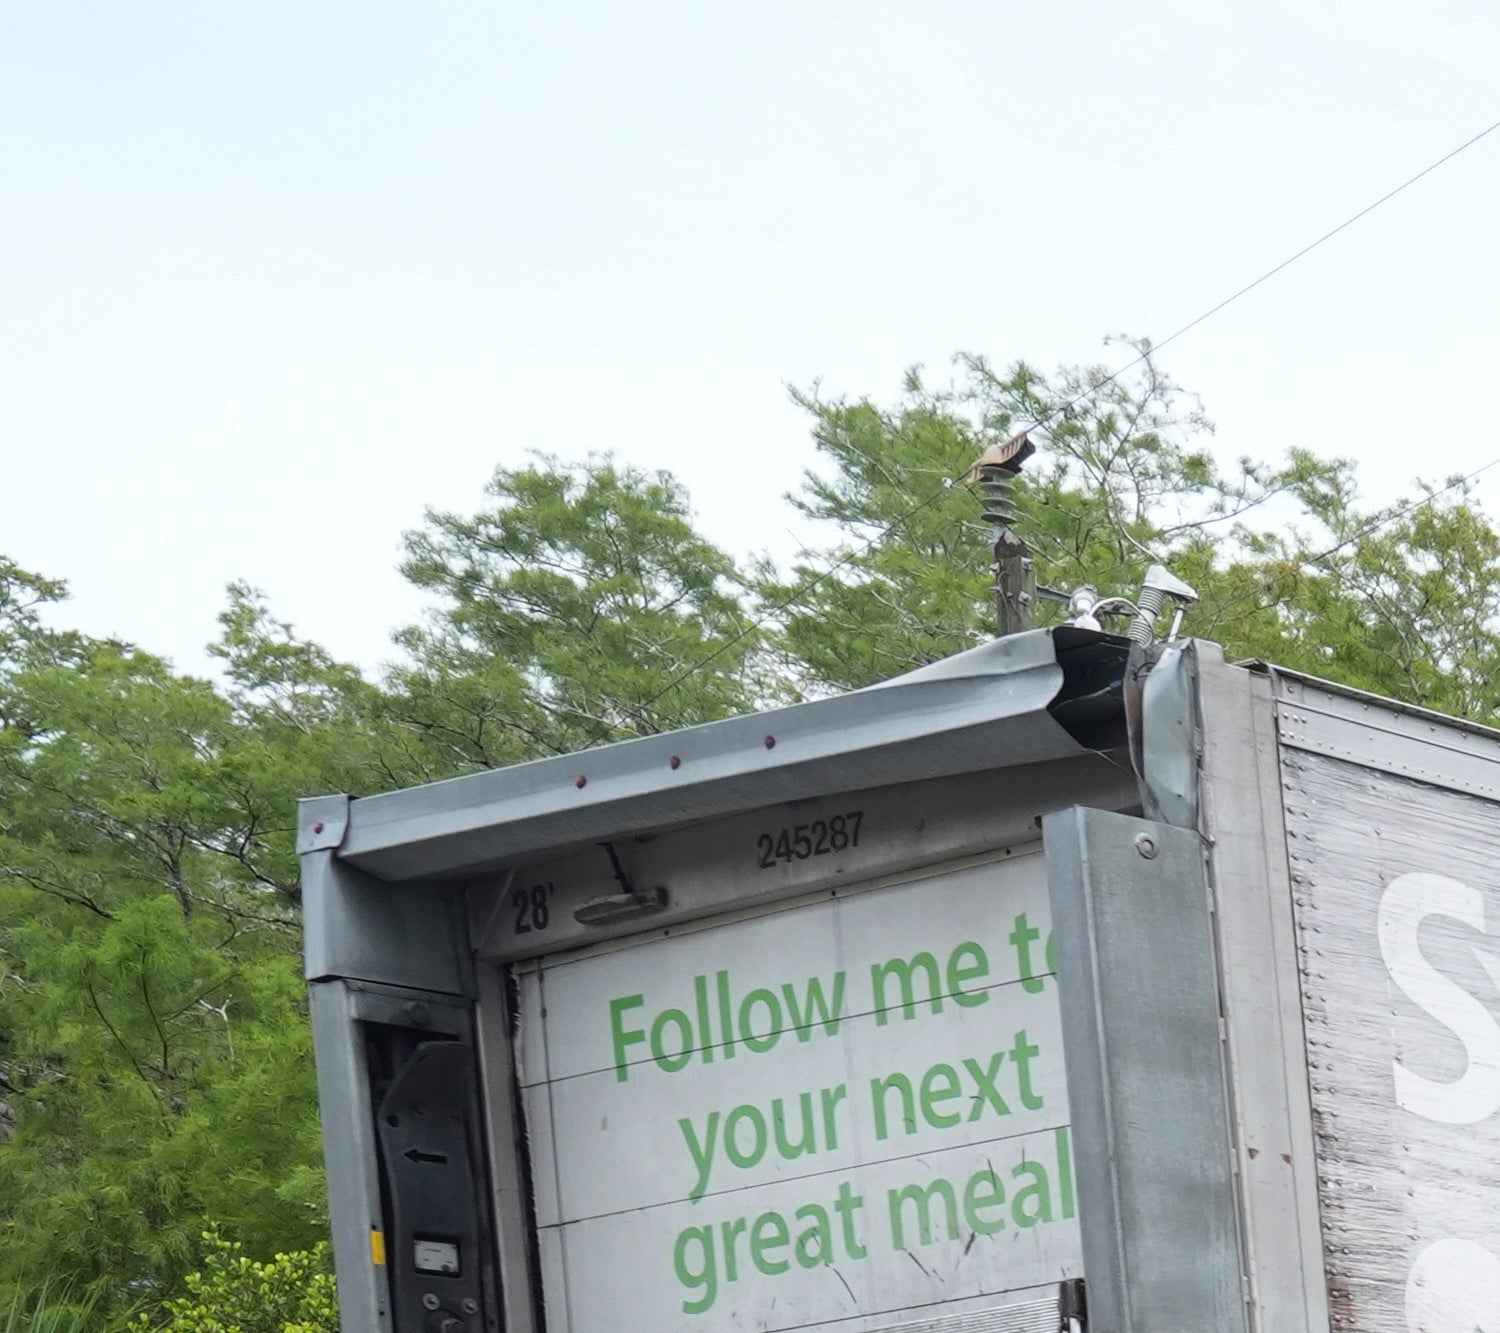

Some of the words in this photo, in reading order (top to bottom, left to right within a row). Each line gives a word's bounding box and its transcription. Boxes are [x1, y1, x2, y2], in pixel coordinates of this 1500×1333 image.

[756, 810, 865, 870] 245287
[608, 969, 846, 1084] Follow
[870, 941, 990, 1028] me
[677, 1082, 847, 1206] your
[870, 1028, 1044, 1142] next
[672, 1180, 868, 1316] great
[887, 1126, 1076, 1251] meal
